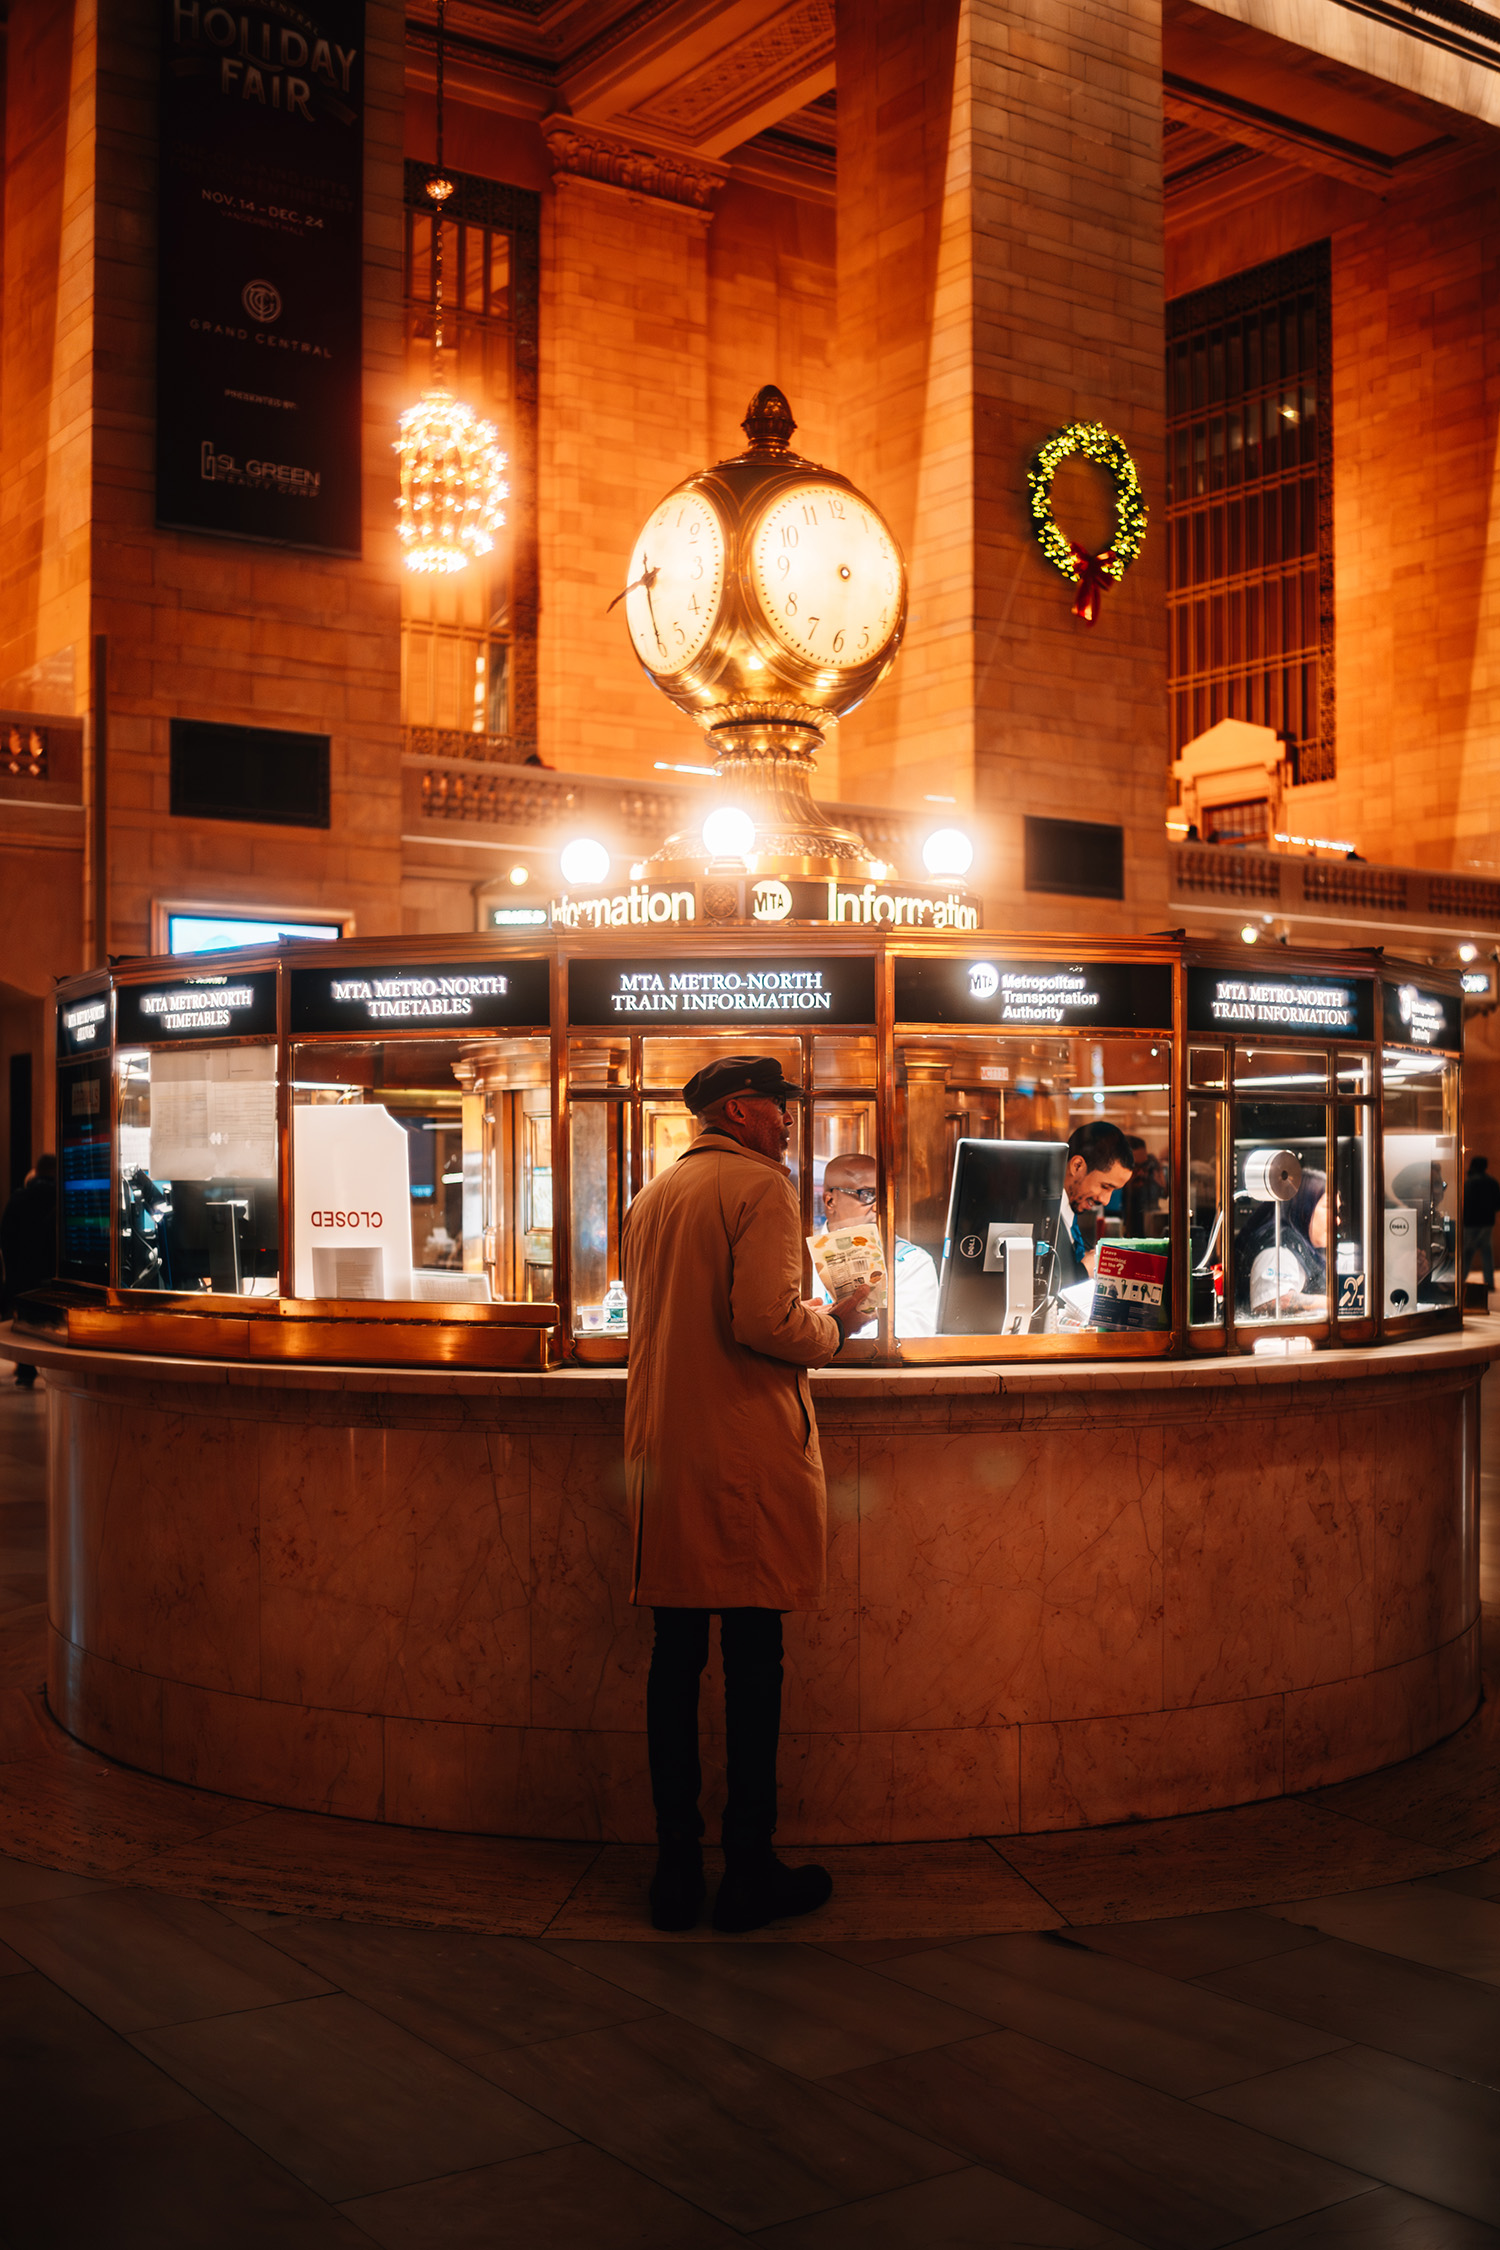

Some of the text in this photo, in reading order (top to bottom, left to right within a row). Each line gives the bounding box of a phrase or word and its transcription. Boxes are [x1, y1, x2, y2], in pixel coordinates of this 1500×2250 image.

[173, 0, 357, 93] HOLIDAY
[221, 56, 315, 122] FAIR
[268, 205, 303, 224] DEC.
[305, 214, 324, 230] 24
[189, 318, 333, 360] GRAND CENTRAL
[217, 454, 320, 487] SL GREEN
[802, 505, 818, 526] 11
[828, 499, 846, 520] 12
[781, 525, 799, 548] 10
[690, 556, 703, 580] 3
[777, 556, 790, 582] 9
[688, 592, 701, 616] 4
[785, 592, 798, 617] 8
[808, 616, 820, 641] 7
[878, 606, 888, 630] 4
[673, 621, 685, 645] 5
[833, 629, 846, 653] 6
[857, 626, 869, 650] 5
[335, 977, 506, 999] MTA METRO-NORTH
[620, 972, 822, 991] MTA METRO-NORTH
[1002, 975, 1083, 991] Metropolitan
[144, 990, 252, 1013] MTA METRO-NORTH
[368, 998, 472, 1017] TIMETABLES
[611, 993, 831, 1011] TRAIN INFORMATION
[1003, 991, 1098, 1006] Transportation
[1217, 983, 1344, 1008] MTA METRO-NORTH
[165, 1010, 229, 1029] TIMETABLES
[1003, 1006, 1064, 1022] Authority
[1212, 1002, 1349, 1026] TRAIN INFORMATION
[311, 1211, 383, 1228] CLOSED
[1116, 1263, 1124, 1275] ?
[1357, 1295, 1364, 1306] T
